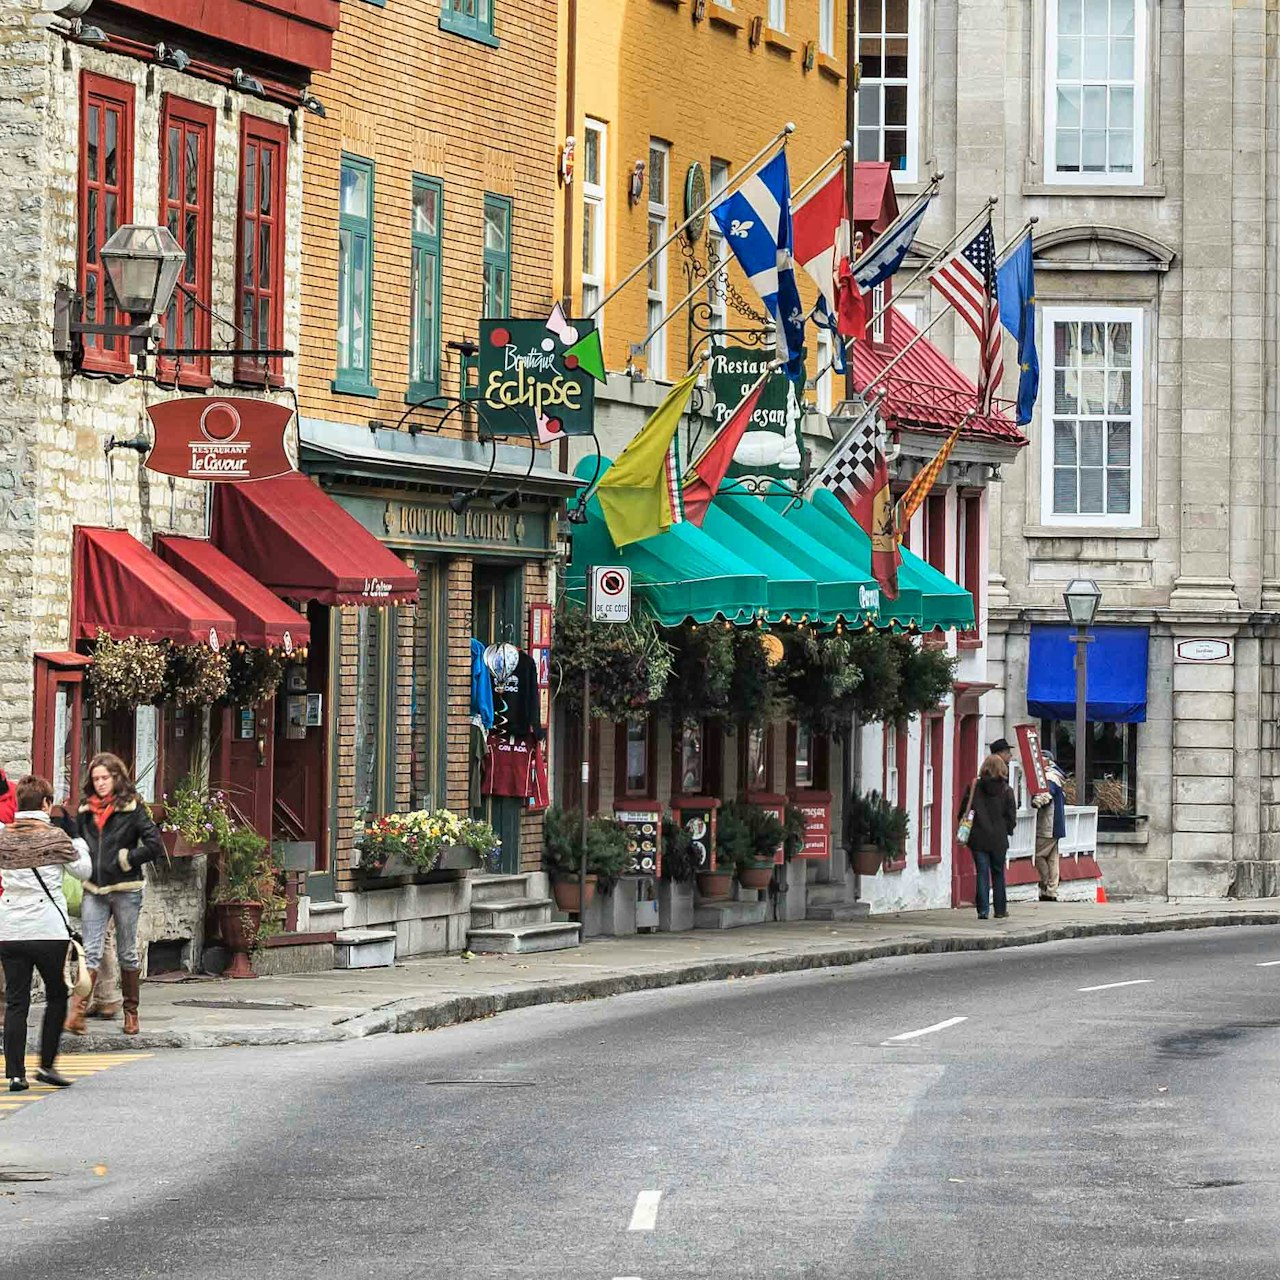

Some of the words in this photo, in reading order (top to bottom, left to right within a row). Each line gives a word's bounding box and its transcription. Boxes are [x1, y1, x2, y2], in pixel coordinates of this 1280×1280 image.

[504, 343, 562, 376] Boutique
[485, 360, 582, 419] Eclipse
[714, 402, 787, 427] Paesan
[192, 453, 203, 470] le
[204, 453, 248, 471] Cavour
[399, 505, 460, 541] BOUTIQUE
[597, 604, 604, 612] DE
[606, 604, 613, 612] CE
